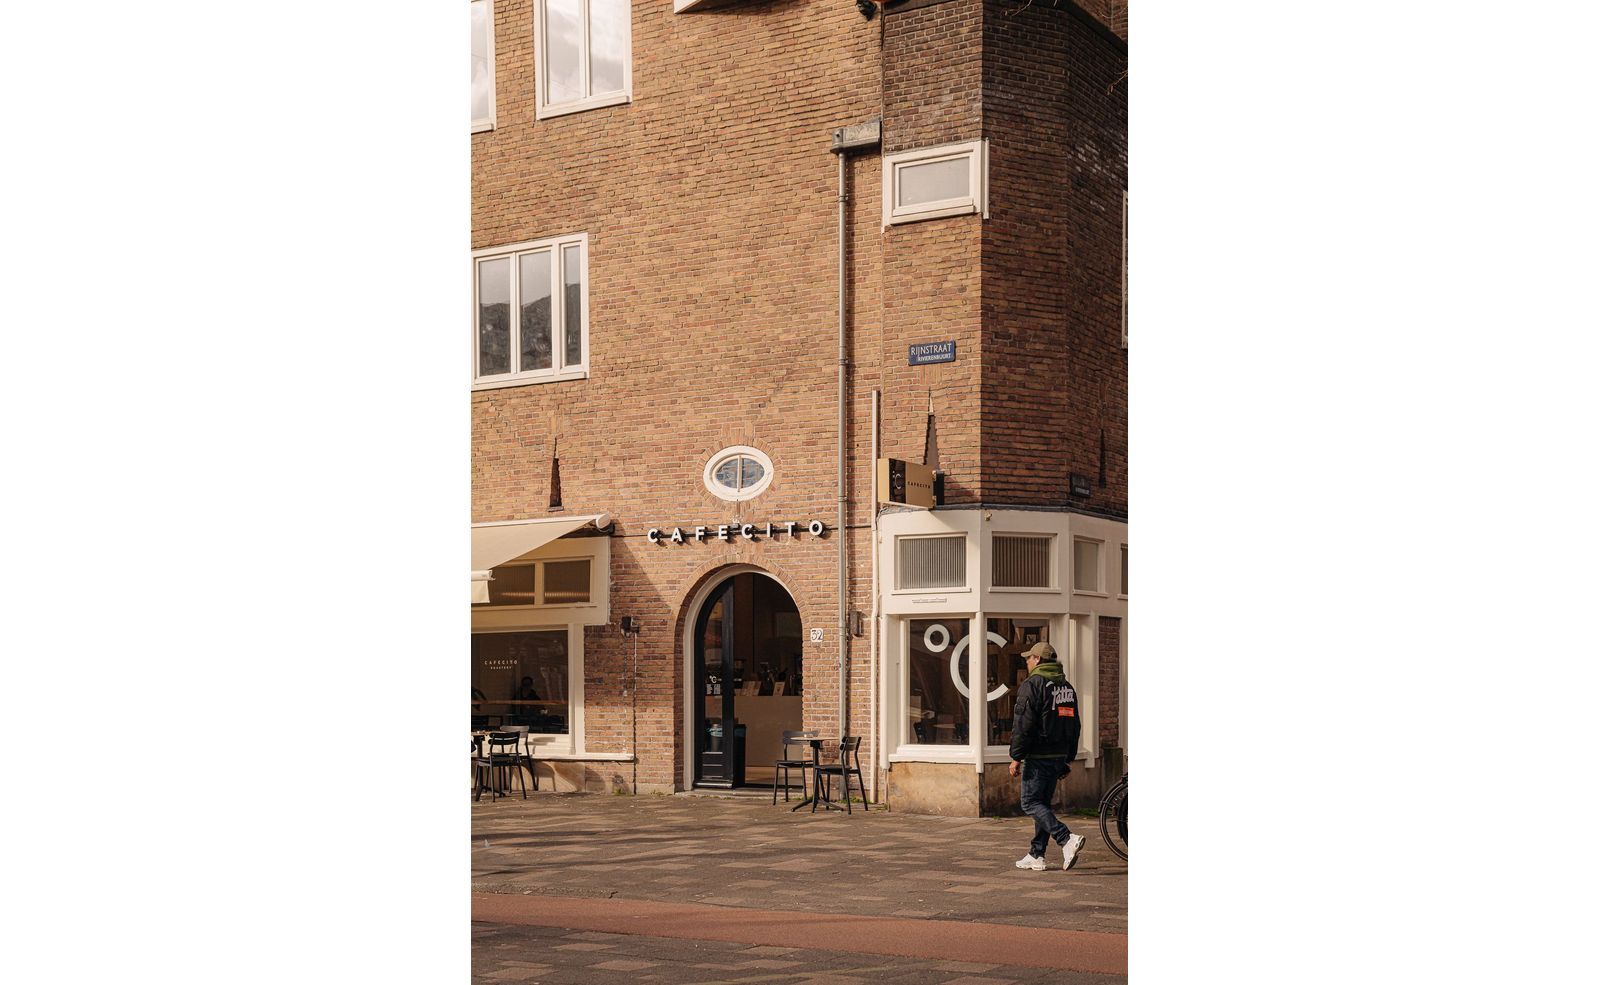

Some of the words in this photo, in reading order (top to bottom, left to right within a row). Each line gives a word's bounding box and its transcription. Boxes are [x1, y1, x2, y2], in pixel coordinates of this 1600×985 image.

[910, 343, 952, 356] RIJNSTRAAT
[647, 520, 823, 543] CAFECITO
[811, 629, 823, 641] 32
